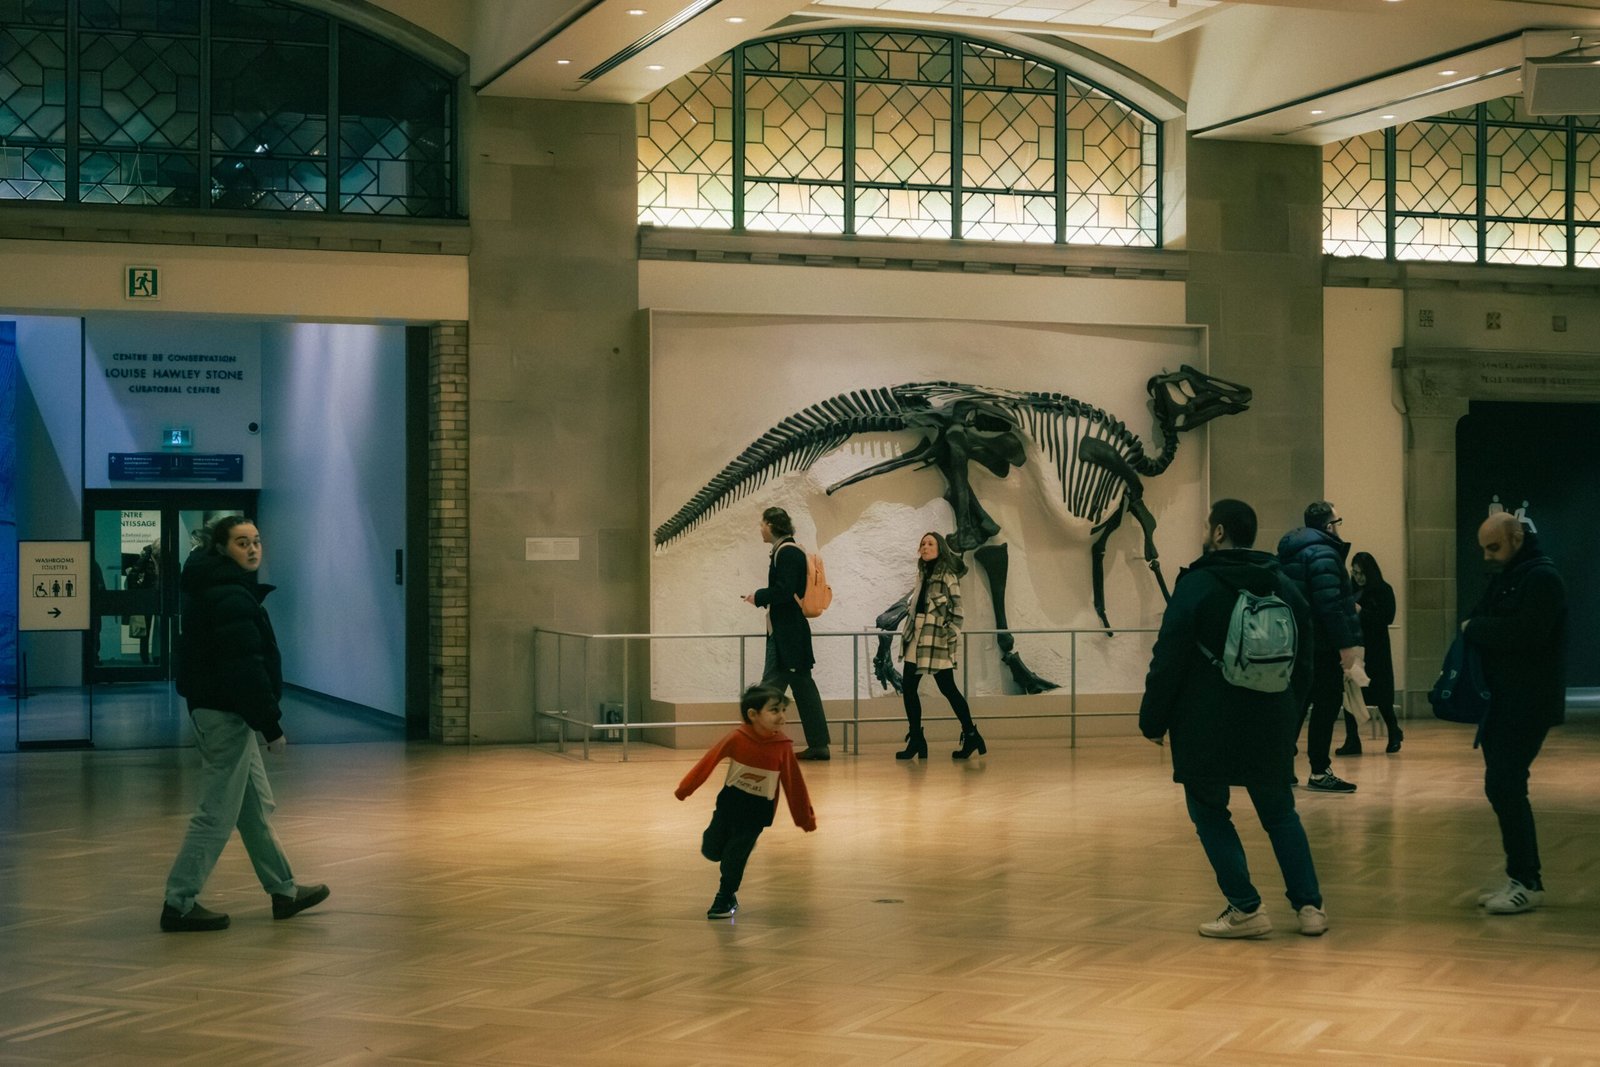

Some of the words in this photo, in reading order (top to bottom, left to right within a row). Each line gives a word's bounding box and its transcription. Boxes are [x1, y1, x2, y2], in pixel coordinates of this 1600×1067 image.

[112, 353, 148, 361] CENTRE
[167, 354, 237, 363] CONSERVATION
[105, 368, 146, 378] LOUISE
[153, 369, 200, 379] HAWLEY
[205, 370, 243, 380] STONE
[128, 385, 182, 394] CURATORIAL
[186, 386, 221, 394] CENTRE
